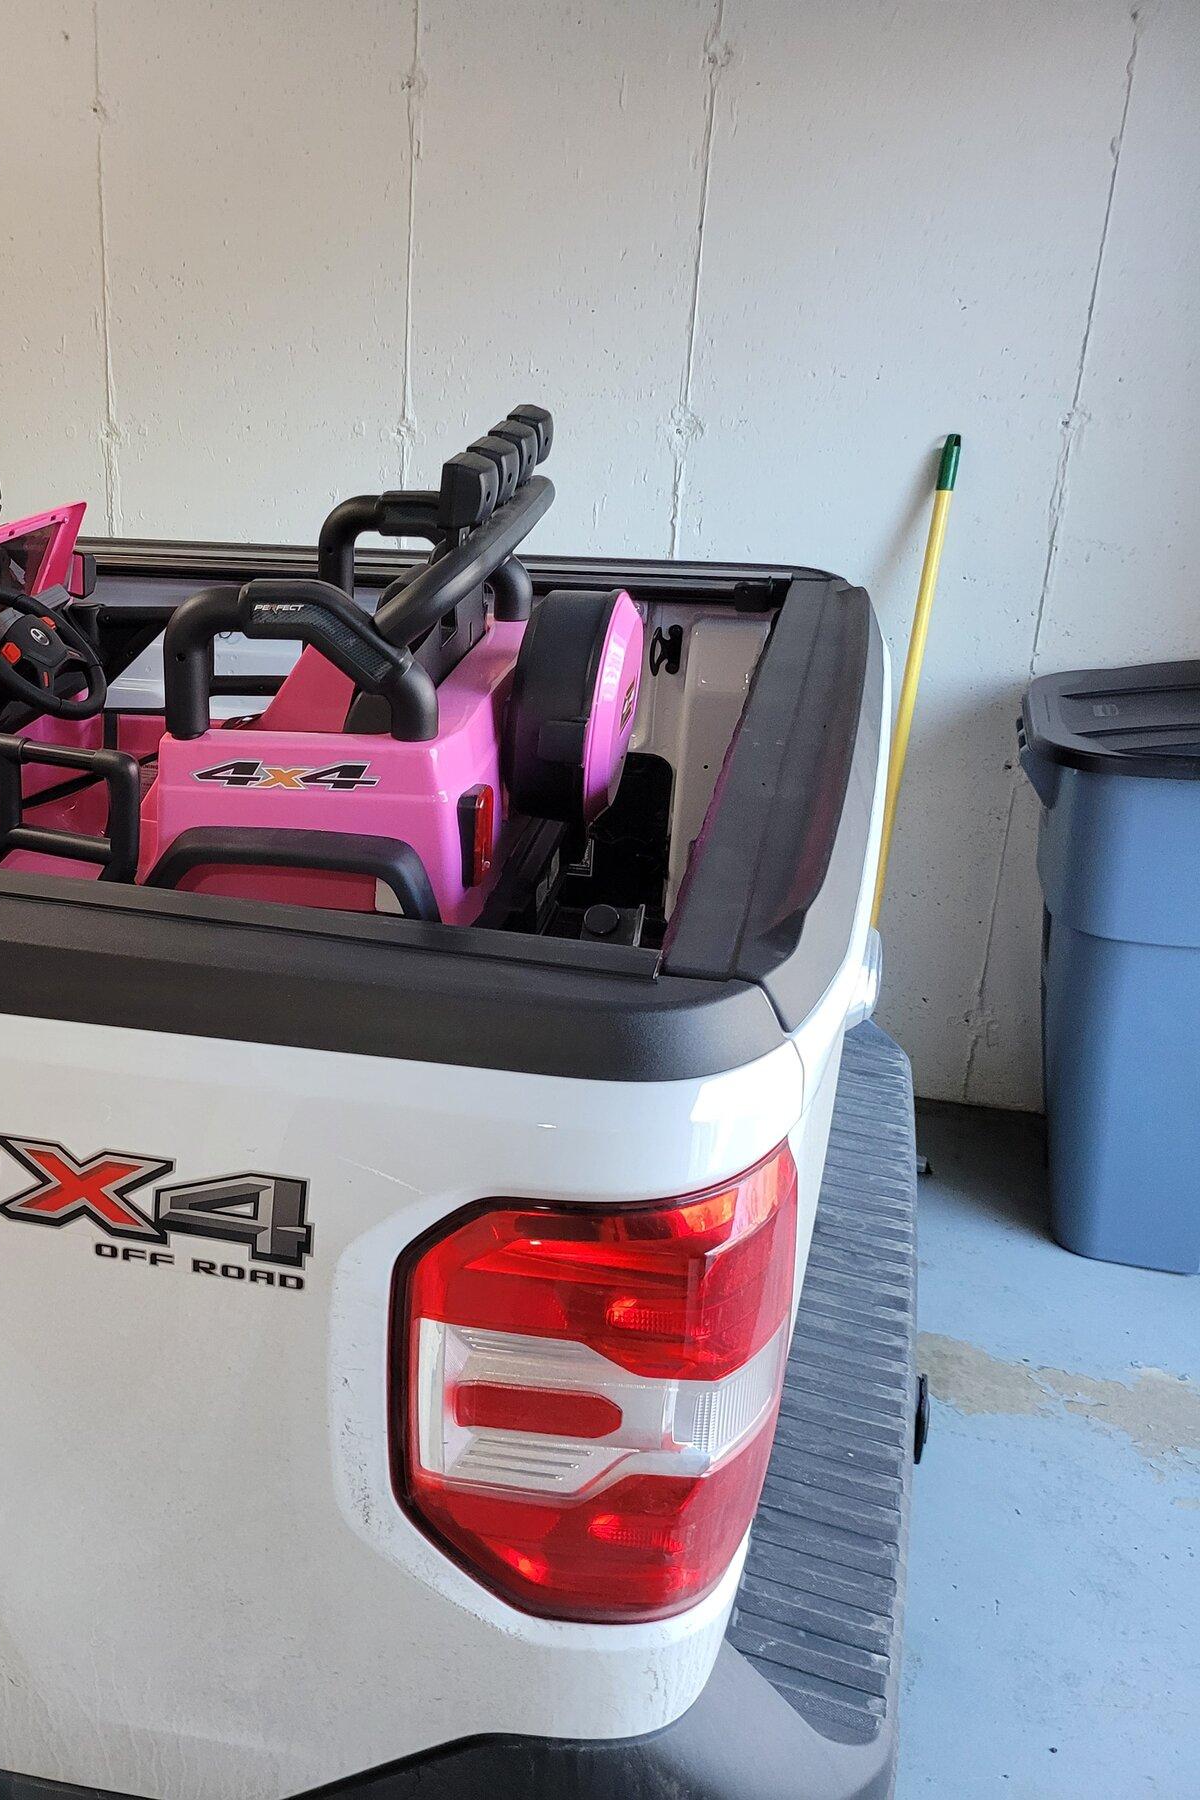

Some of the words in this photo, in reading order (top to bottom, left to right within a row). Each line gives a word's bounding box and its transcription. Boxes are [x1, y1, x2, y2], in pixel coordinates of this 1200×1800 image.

[254, 603, 305, 614] PERFECT
[191, 762, 381, 791] 4x4
[94, 1242, 175, 1267] OFF
[191, 1257, 305, 1290] ROAD
